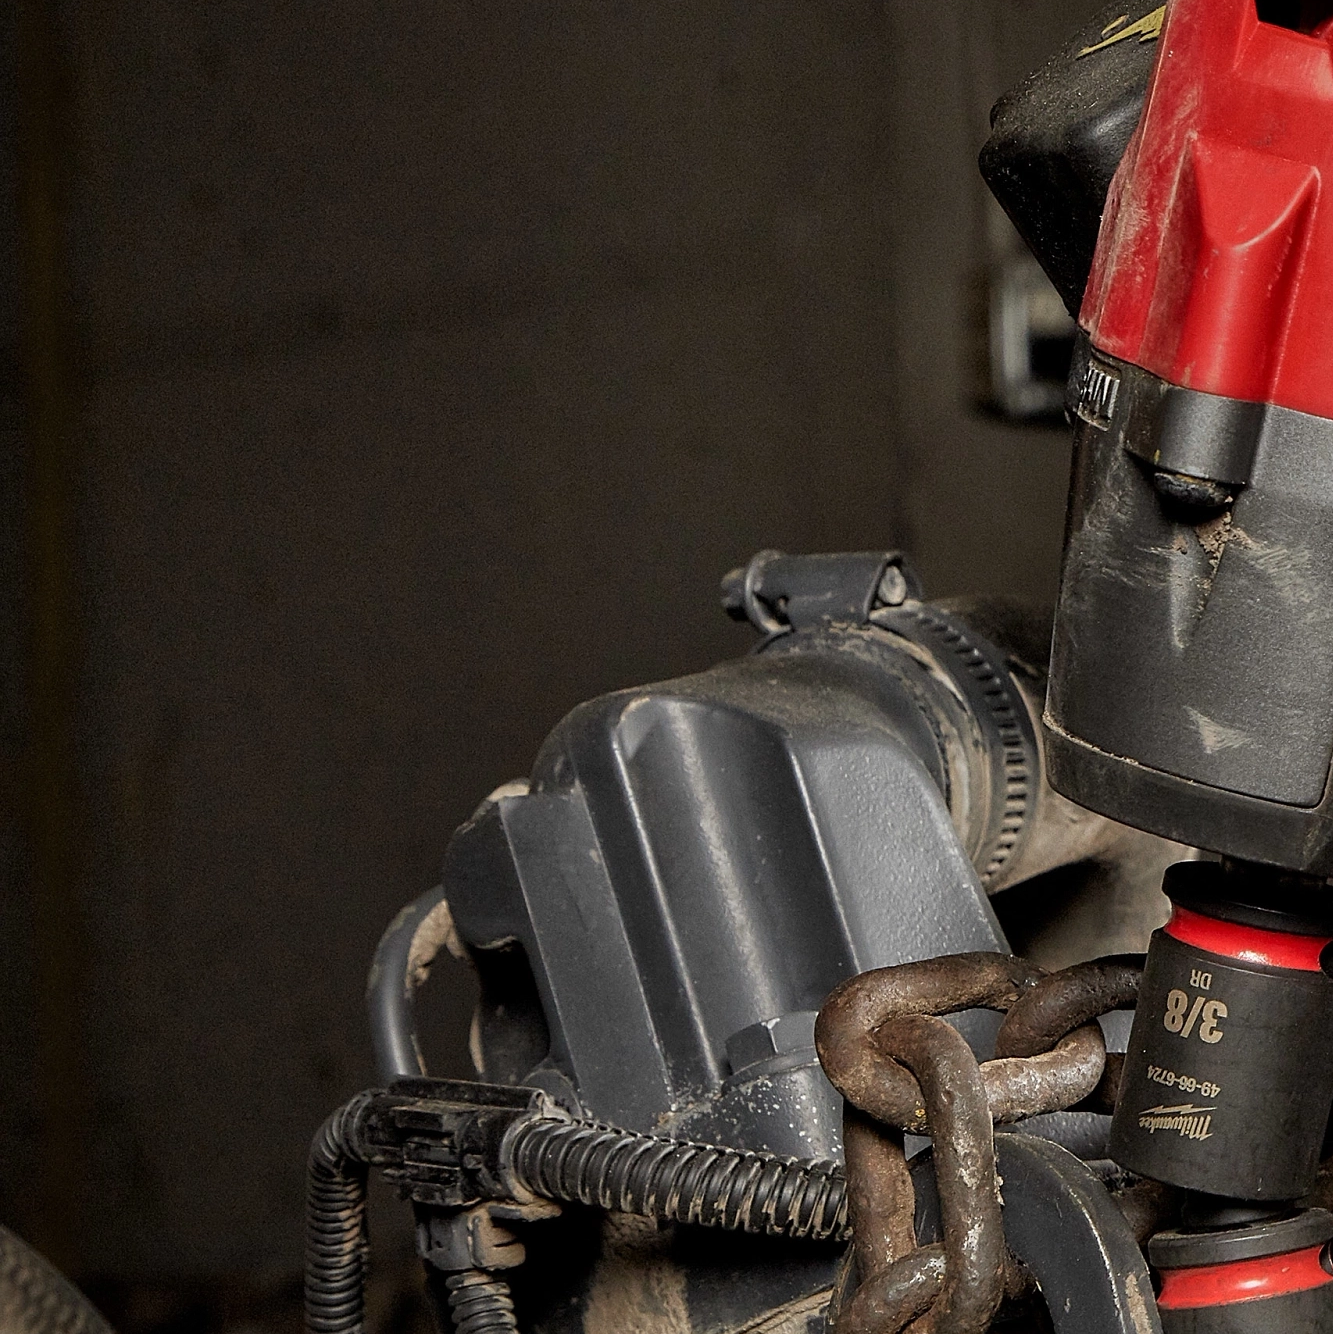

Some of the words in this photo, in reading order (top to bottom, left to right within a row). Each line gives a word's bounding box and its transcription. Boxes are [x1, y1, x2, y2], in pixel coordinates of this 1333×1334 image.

[1190, 969, 1212, 990] DR
[1163, 988, 1228, 1044] 3/8
[1147, 1064, 1220, 1098] 49-66-6724
[1139, 1115, 1213, 1141] Milwaukee
